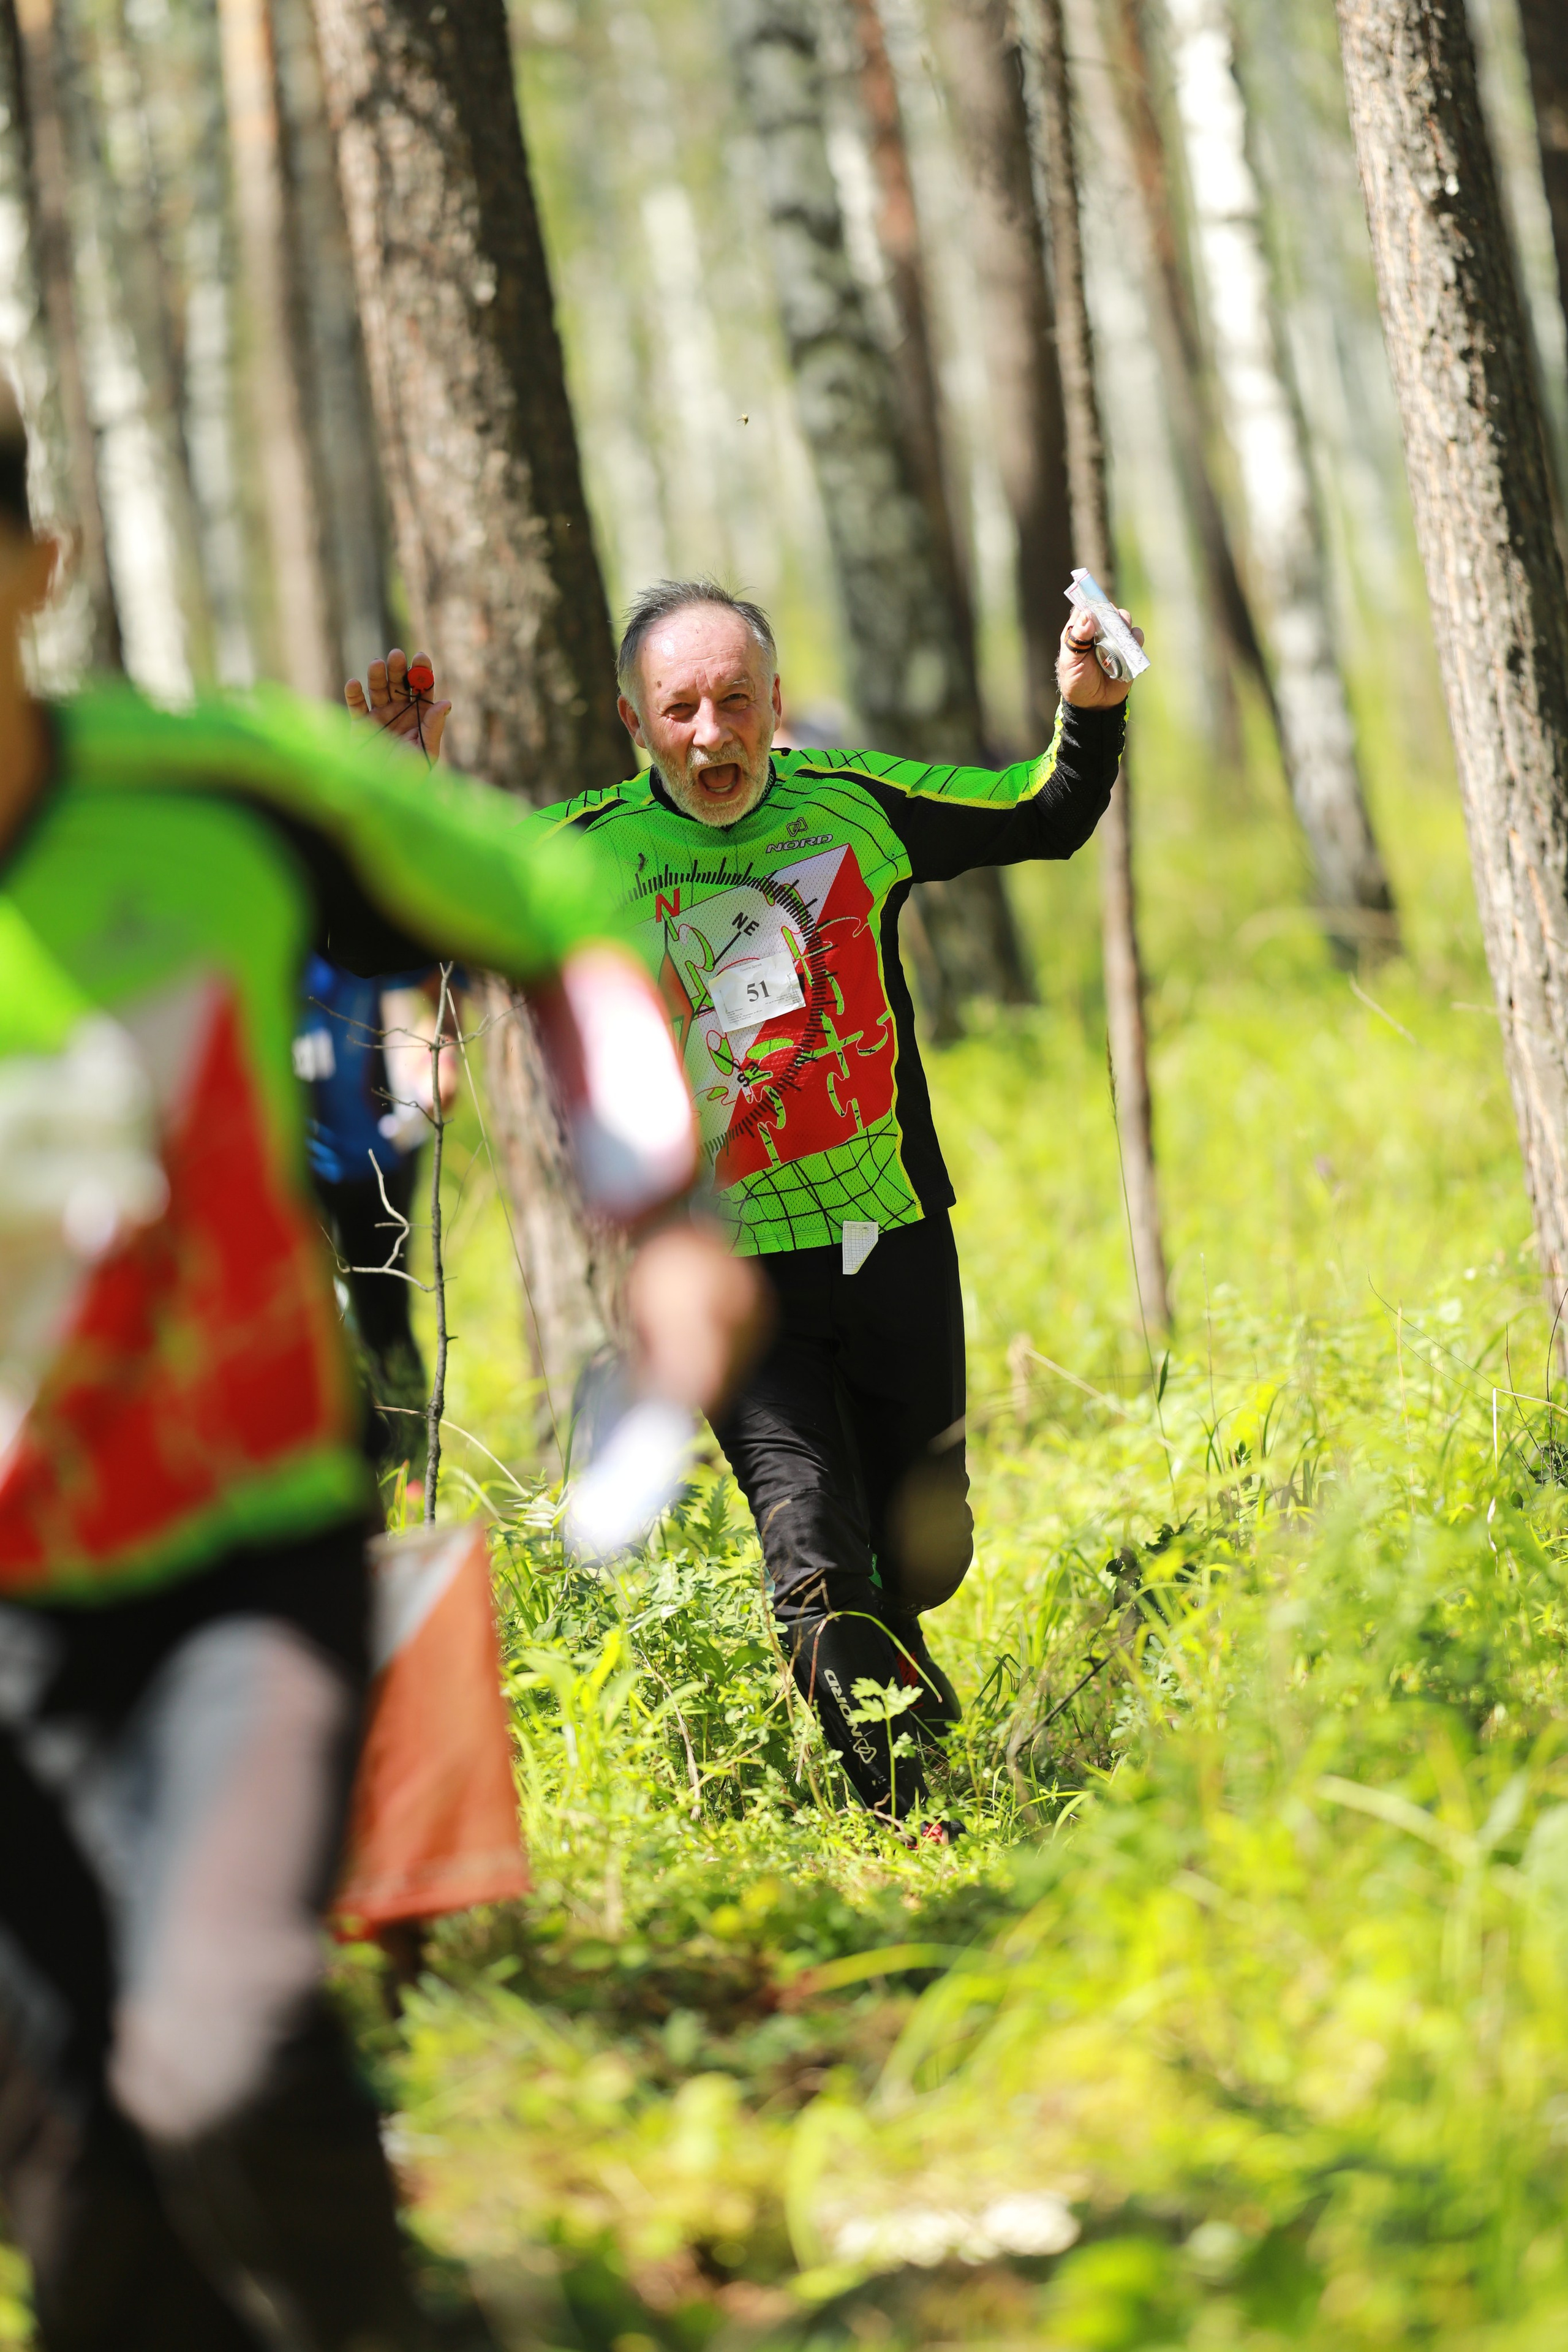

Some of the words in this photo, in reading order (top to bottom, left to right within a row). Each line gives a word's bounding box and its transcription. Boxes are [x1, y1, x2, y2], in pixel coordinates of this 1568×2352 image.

[766, 834, 833, 853] NORD
[655, 888, 680, 923] N
[731, 912, 760, 936] NE
[747, 980, 771, 1002] 51
[824, 1669, 863, 1737] NORD
